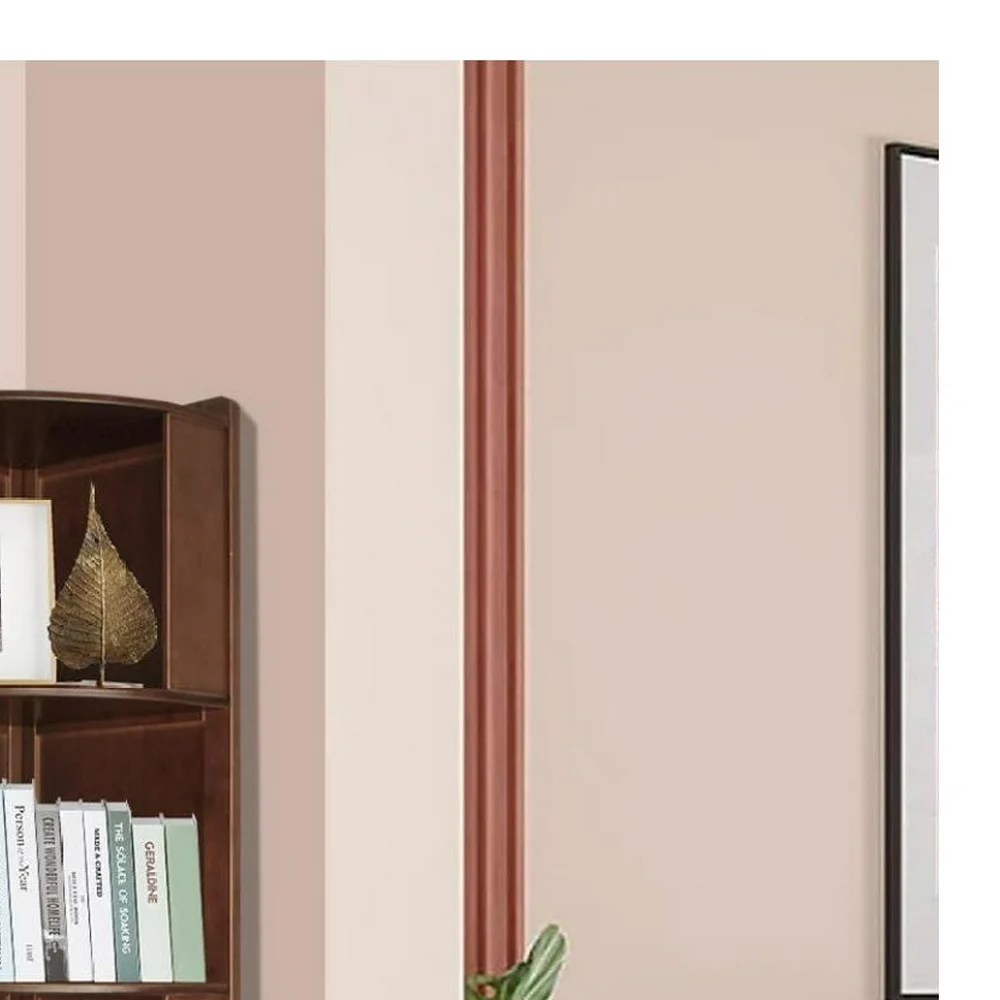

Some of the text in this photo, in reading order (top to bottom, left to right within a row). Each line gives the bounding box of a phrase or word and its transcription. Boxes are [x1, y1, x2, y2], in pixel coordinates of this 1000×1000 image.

[14, 805, 27, 846] Person
[114, 823, 124, 842] THE
[19, 865, 30, 892] Year
[42, 817, 61, 936] CREATE WONDERFUL HOMELIFE
[144, 841, 158, 904] GERALDINE
[119, 889, 128, 904] OF
[119, 908, 131, 955] SOAKING
